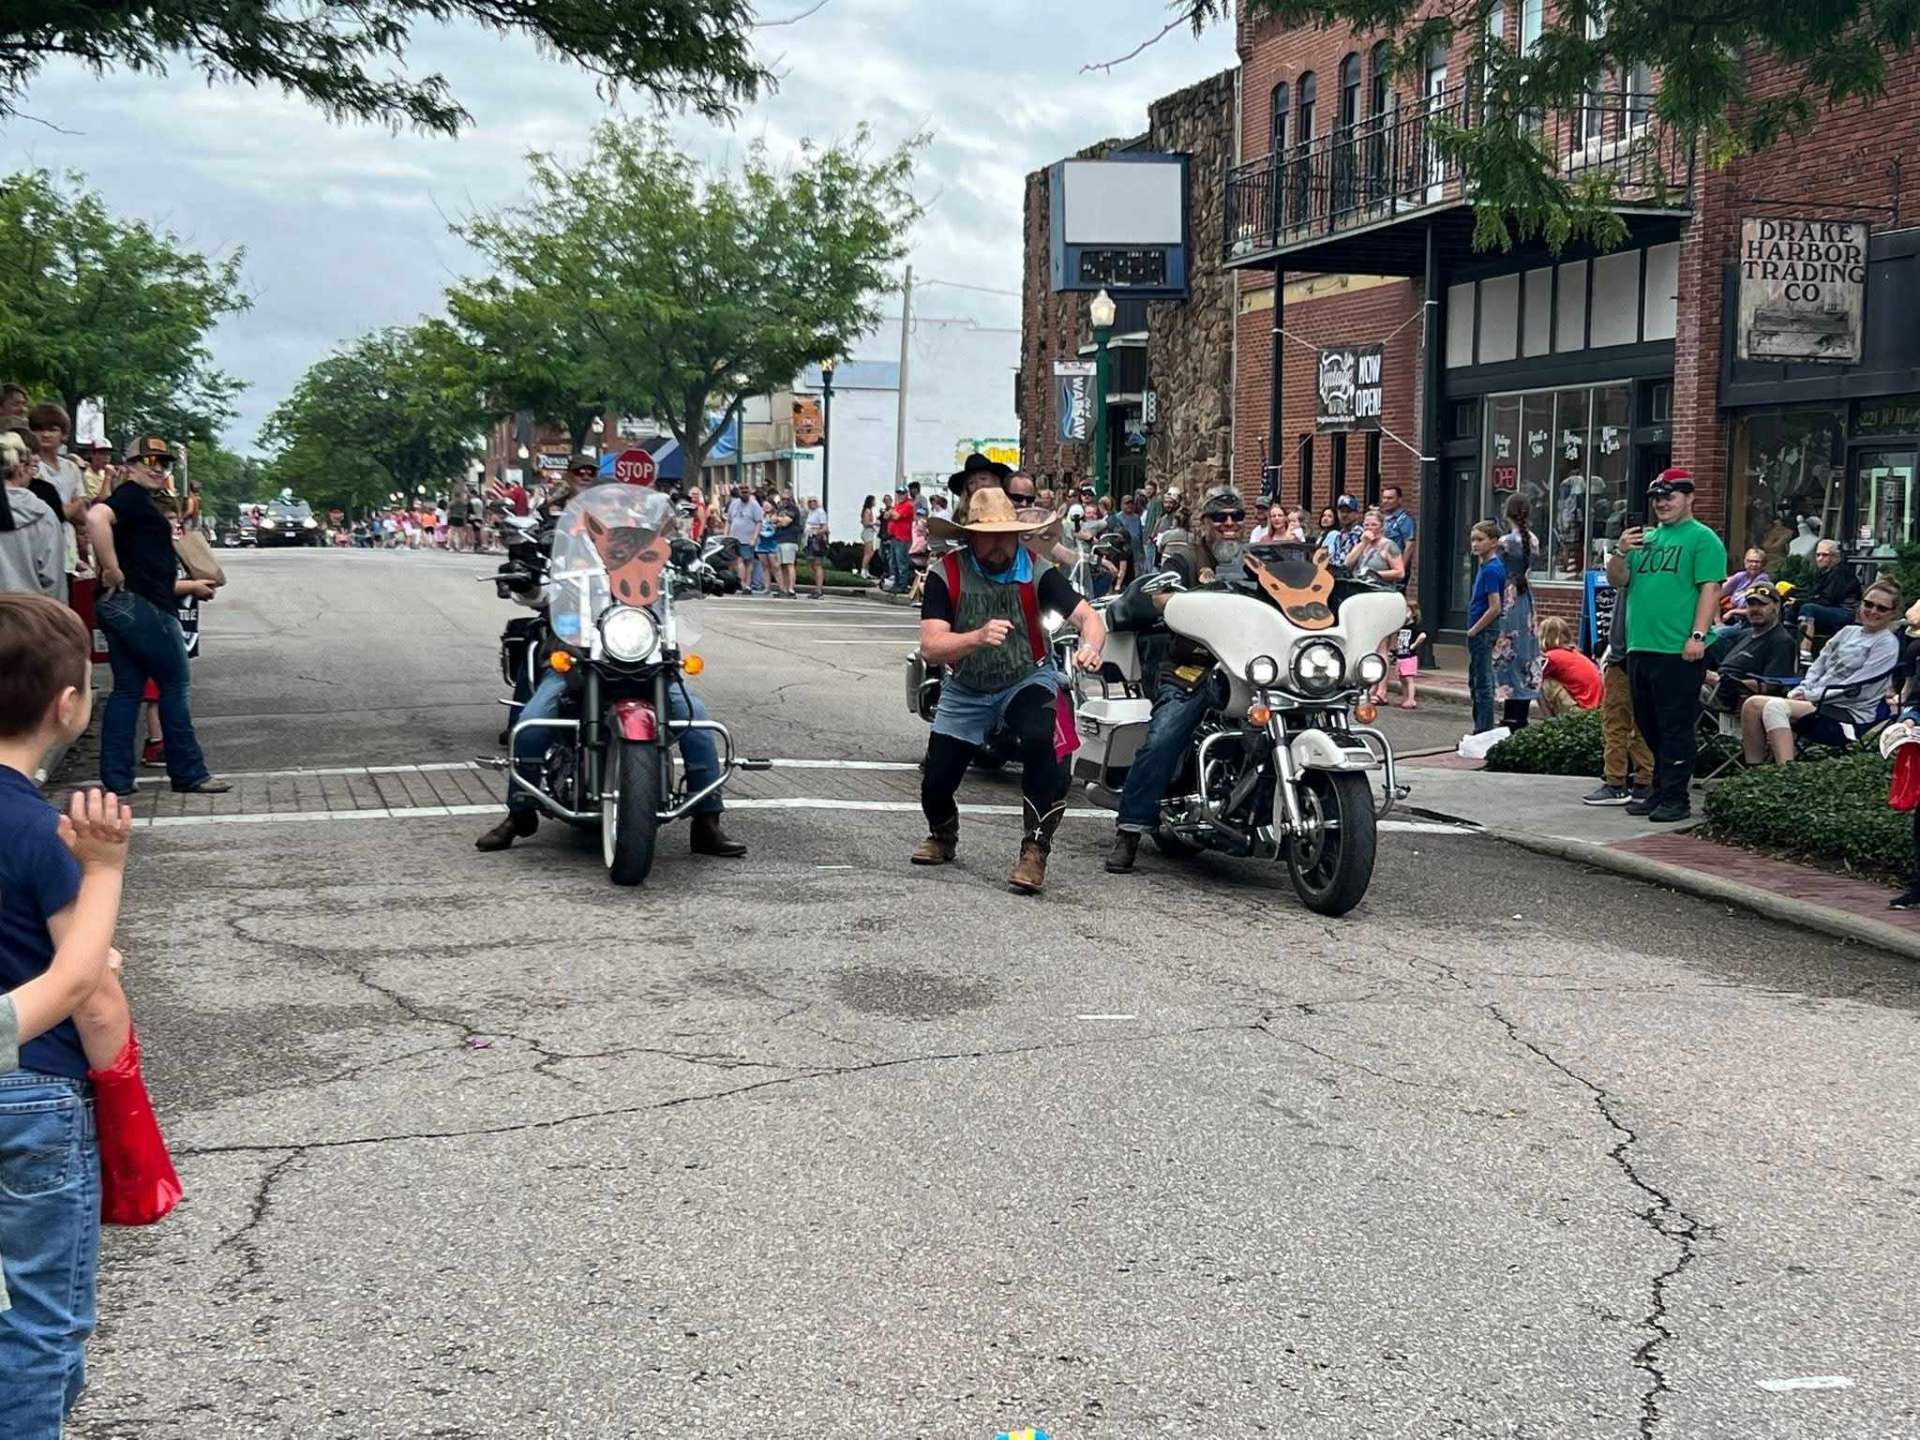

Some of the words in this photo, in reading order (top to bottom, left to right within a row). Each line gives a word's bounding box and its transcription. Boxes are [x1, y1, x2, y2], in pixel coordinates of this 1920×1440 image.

[1759, 220, 1854, 244] DRAKE
[1747, 240, 1862, 264] HARBOR
[1743, 261, 1865, 284] TRADING
[1784, 283, 1821, 302] CO
[1358, 354, 1382, 384] NOW
[1355, 387, 1382, 417] OPEN!
[616, 461, 654, 479] STOP
[1637, 545, 1683, 575] 2021
